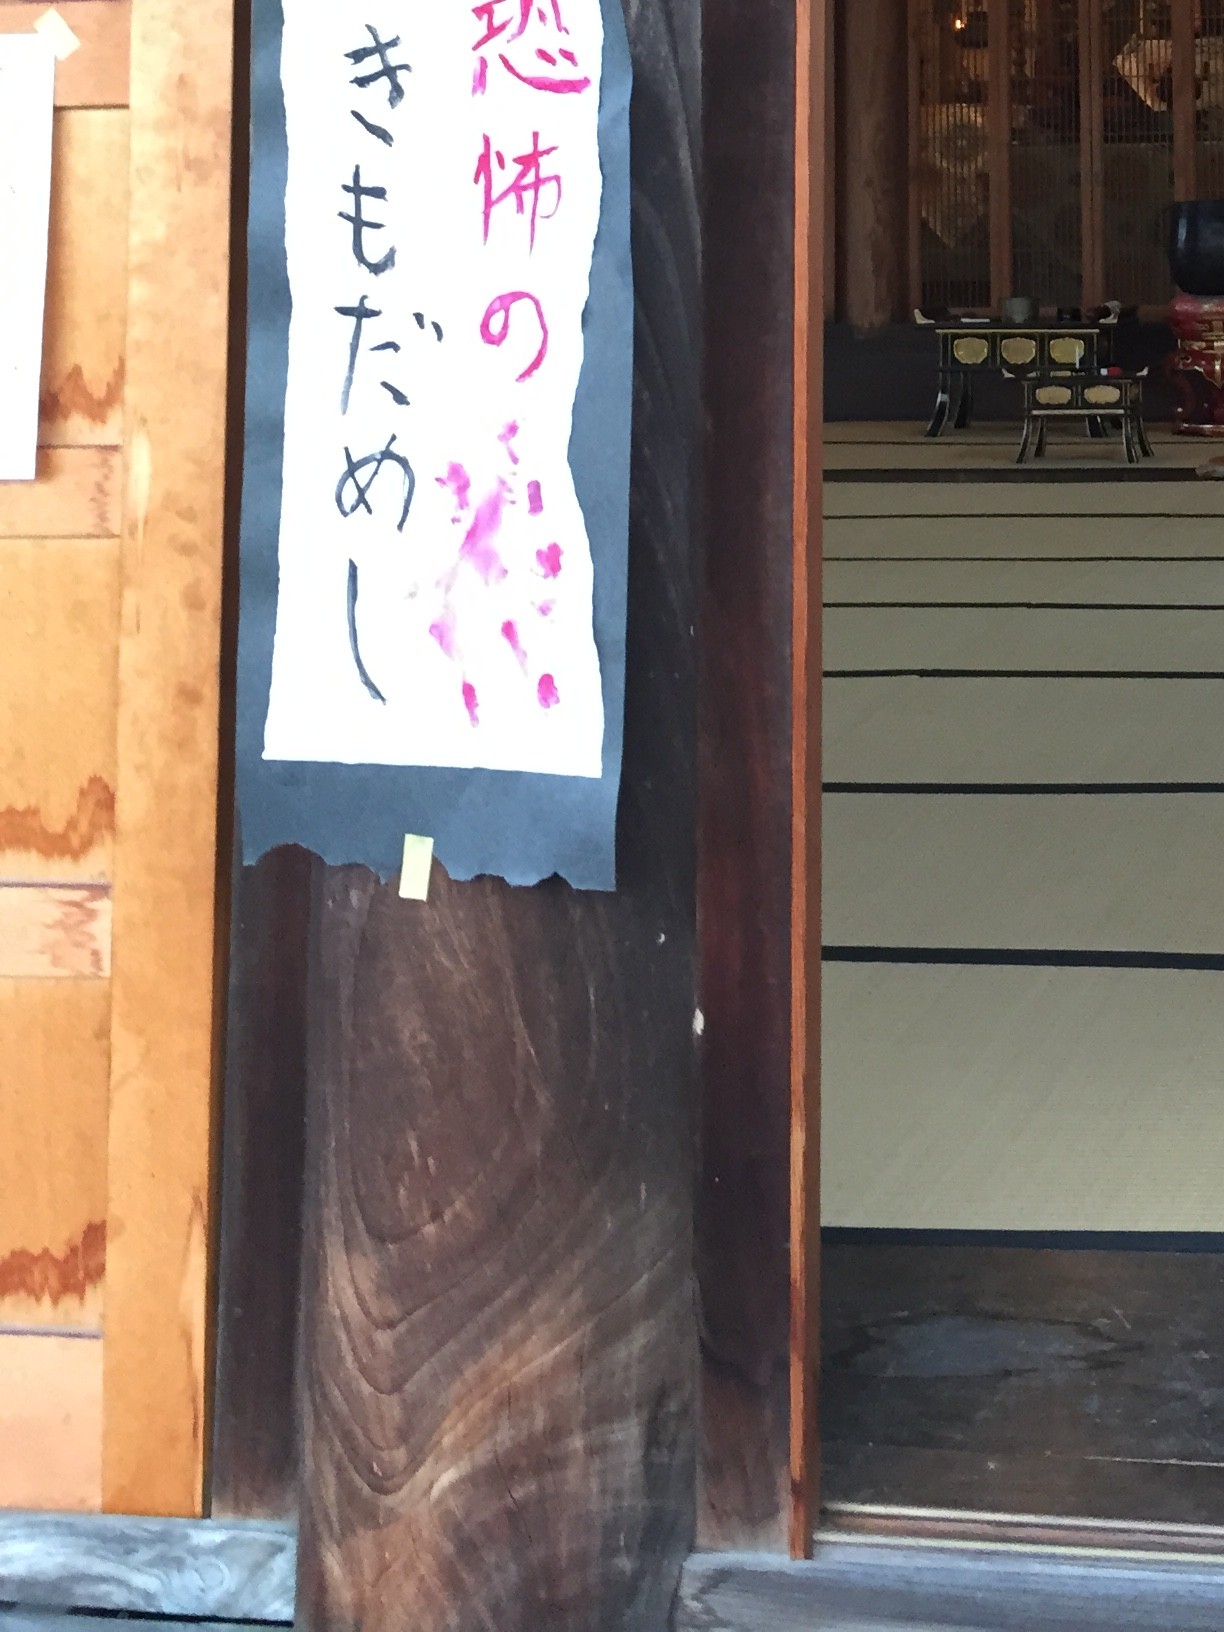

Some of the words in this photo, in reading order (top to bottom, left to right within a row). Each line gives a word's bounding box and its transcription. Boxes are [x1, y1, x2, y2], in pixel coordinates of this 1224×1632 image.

[333, 23, 444, 706] きもだめし
